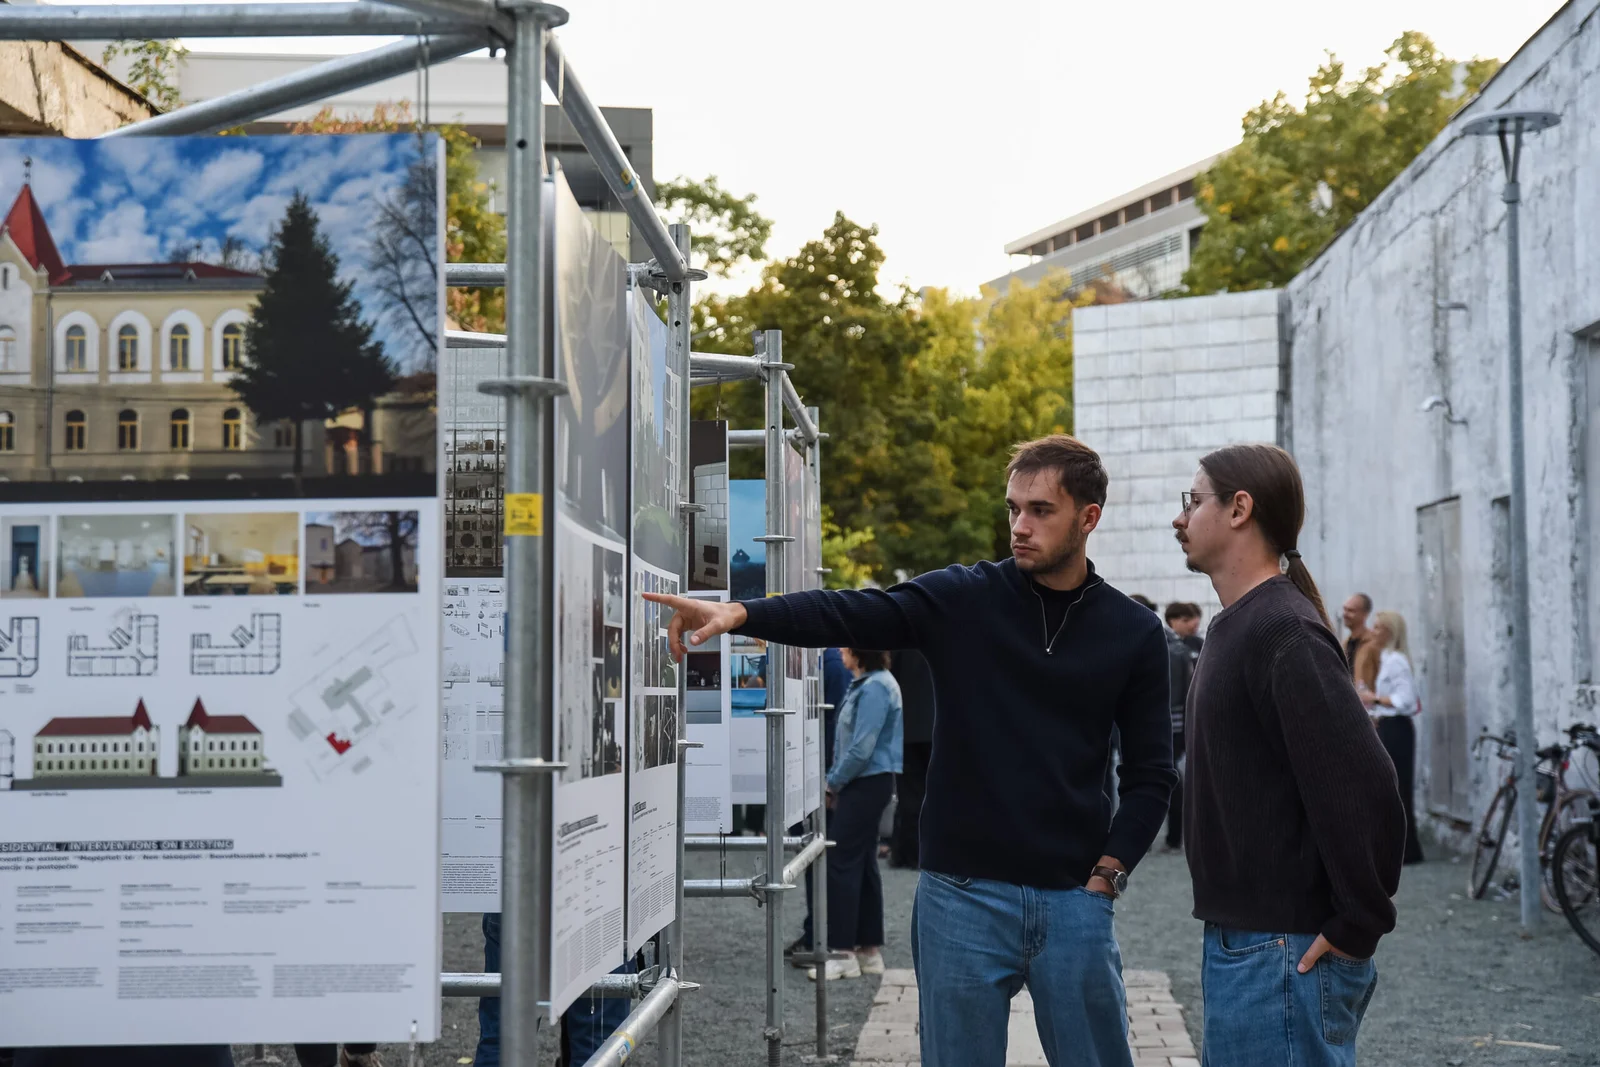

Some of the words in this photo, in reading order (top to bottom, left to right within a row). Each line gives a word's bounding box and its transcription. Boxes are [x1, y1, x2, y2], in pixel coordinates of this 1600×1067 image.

[70, 841, 159, 851] INTERVENTIONS
[162, 840, 179, 850] ON
[182, 840, 234, 850] EXISTING
